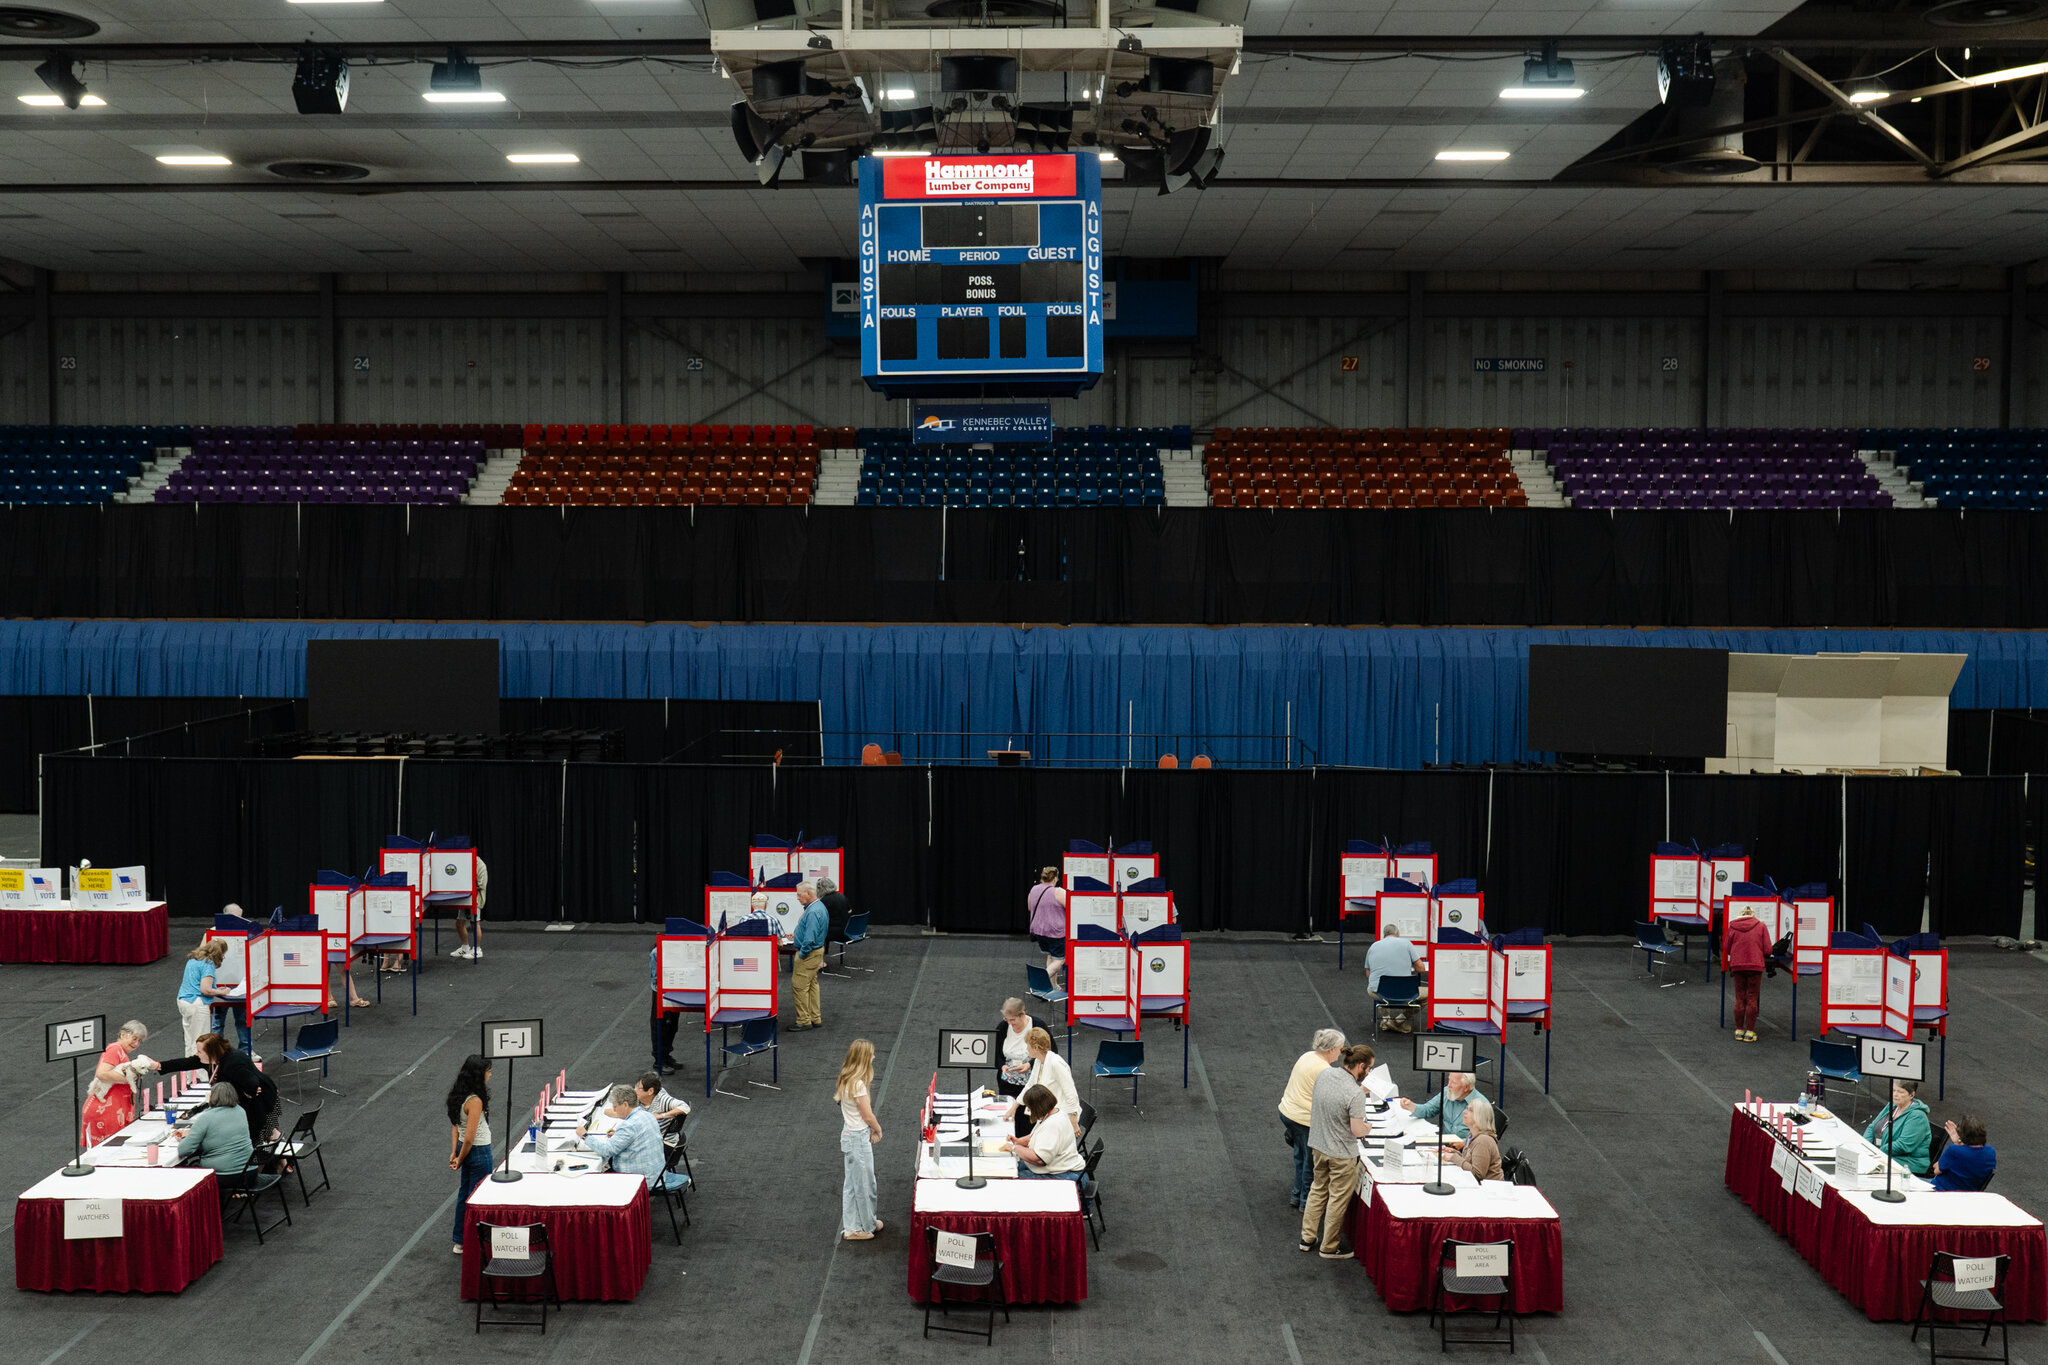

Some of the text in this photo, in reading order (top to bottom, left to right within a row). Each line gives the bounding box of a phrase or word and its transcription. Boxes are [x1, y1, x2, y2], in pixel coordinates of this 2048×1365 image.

[925, 159, 1034, 178] Hammond
[929, 181, 1030, 191] Lumber Company
[888, 250, 930, 262] HOME
[960, 252, 1000, 261] PERIOD
[1028, 248, 1076, 260] GUEST
[862, 204, 874, 328] AUGUSTA
[1088, 201, 1100, 325] AUGUSTA
[969, 276, 994, 286] POSS.
[966, 289, 996, 298] BONUS
[881, 308, 916, 318] FOULS
[942, 306, 1026, 316] PLAYER FOUL
[1047, 305, 1082, 315] FOULS
[61, 357, 76, 369] 23
[354, 358, 369, 370] 24
[687, 358, 703, 370] 25
[1342, 357, 1358, 370] 27
[1476, 360, 1543, 370] NO SMOKING
[1663, 358, 1678, 370] 28
[1973, 358, 1990, 370] 29
[962, 417, 1047, 426] KENNEBEC VALLEY
[58, 1025, 92, 1047] A-E
[500, 1032, 525, 1049] F-J
[951, 1038, 987, 1055] K-O
[1426, 1046, 1460, 1063] P-T
[1870, 1046, 1910, 1068] U-Z
[494, 1244, 527, 1253] WATCHER
[948, 1237, 966, 1248] POLL
[938, 1249, 973, 1262] WATCHER
[1966, 1263, 1985, 1272] POLL
[1958, 1275, 1994, 1286] WATCHER
